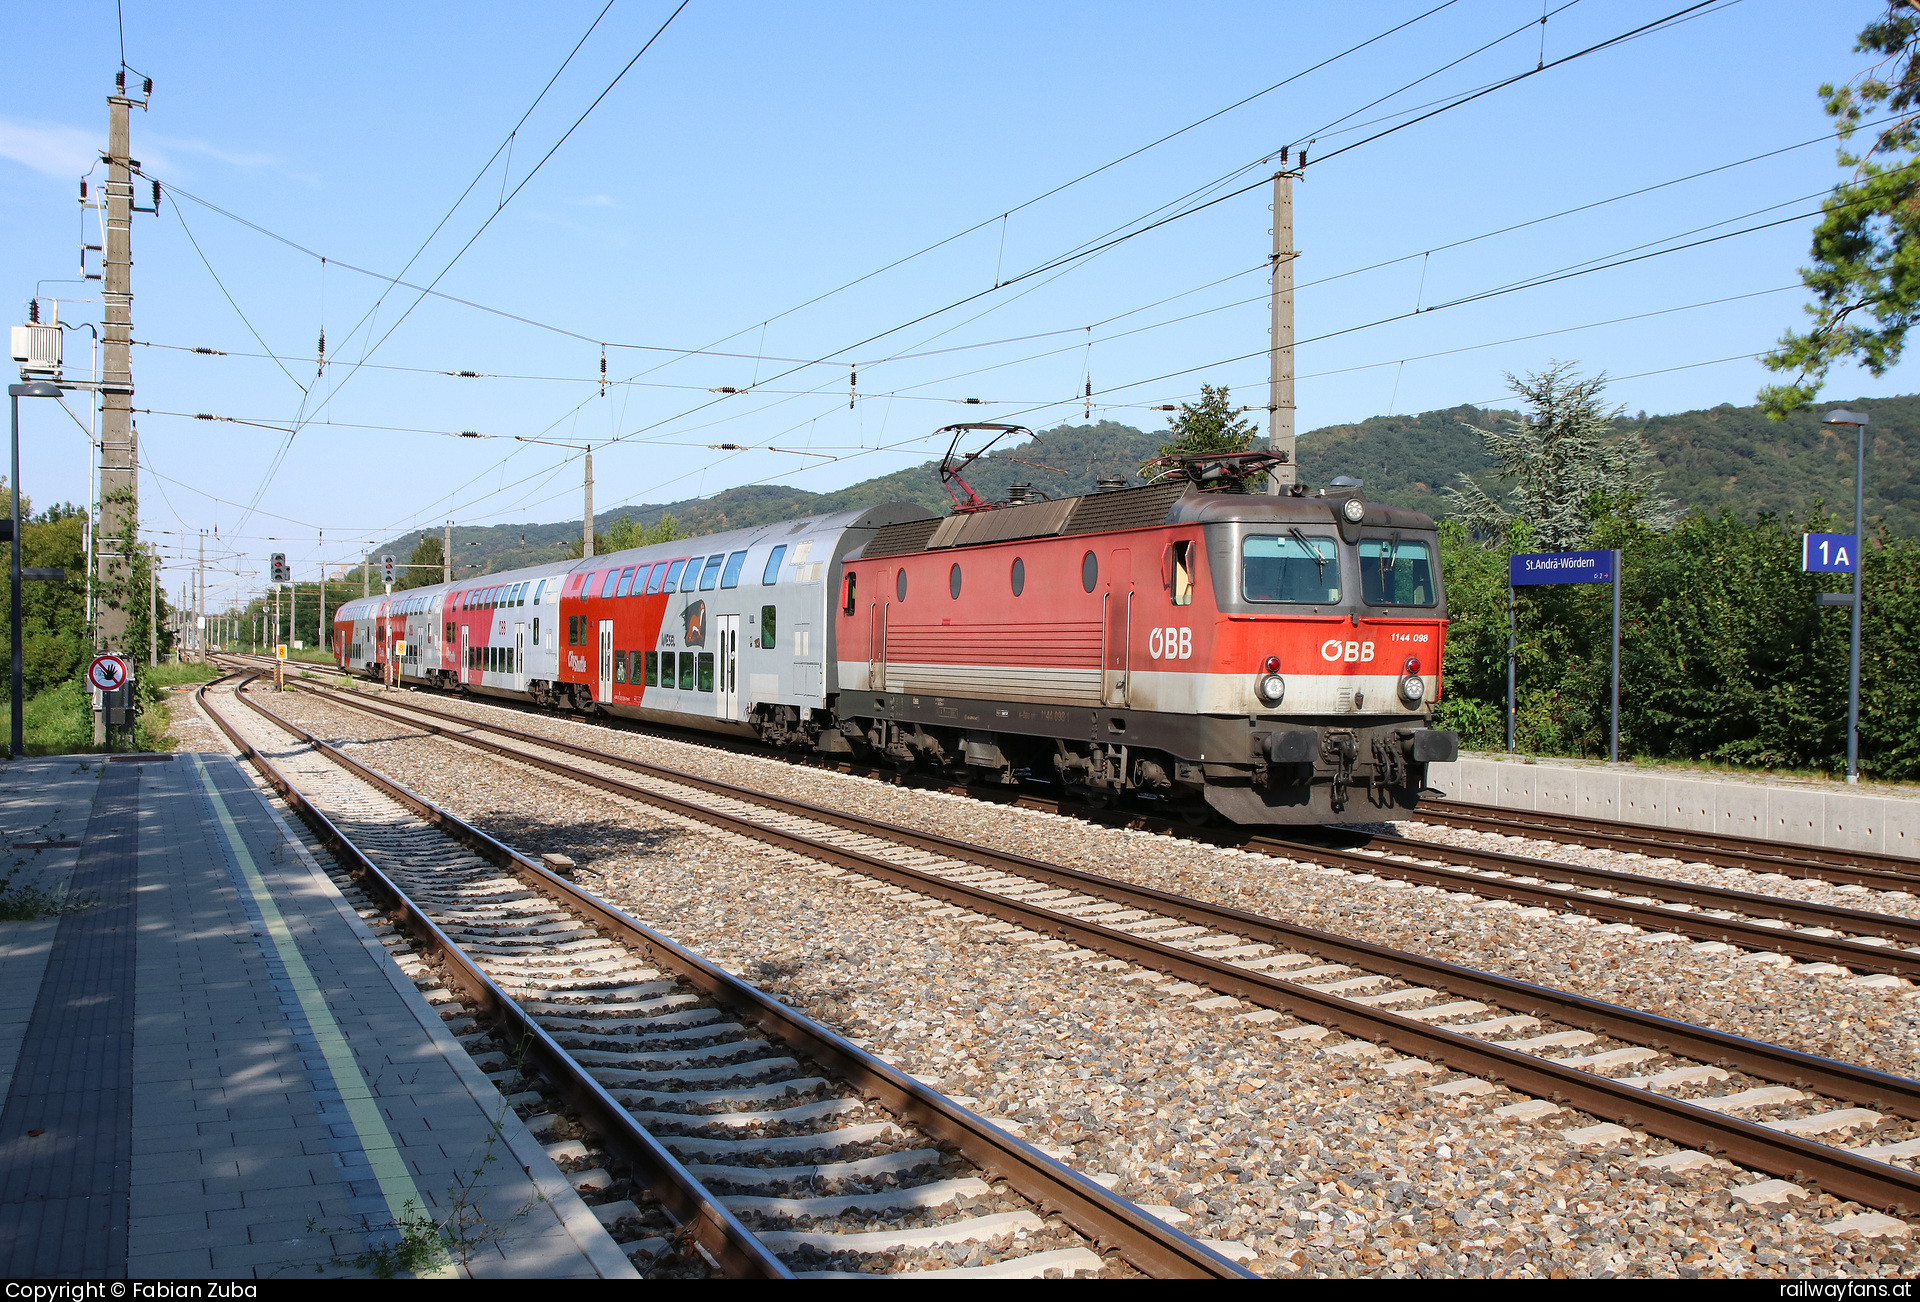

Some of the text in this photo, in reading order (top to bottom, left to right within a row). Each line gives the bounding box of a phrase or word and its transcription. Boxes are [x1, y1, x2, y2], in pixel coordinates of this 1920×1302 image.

[1818, 540, 1850, 566] 1 A
[1525, 556, 1595, 571] St.Andrä-Wördern
[1149, 626, 1193, 660] ÖBB
[1391, 632, 1429, 642] 1144 098
[279, 648, 284, 656] 8
[1321, 639, 1375, 662] ÖBB
